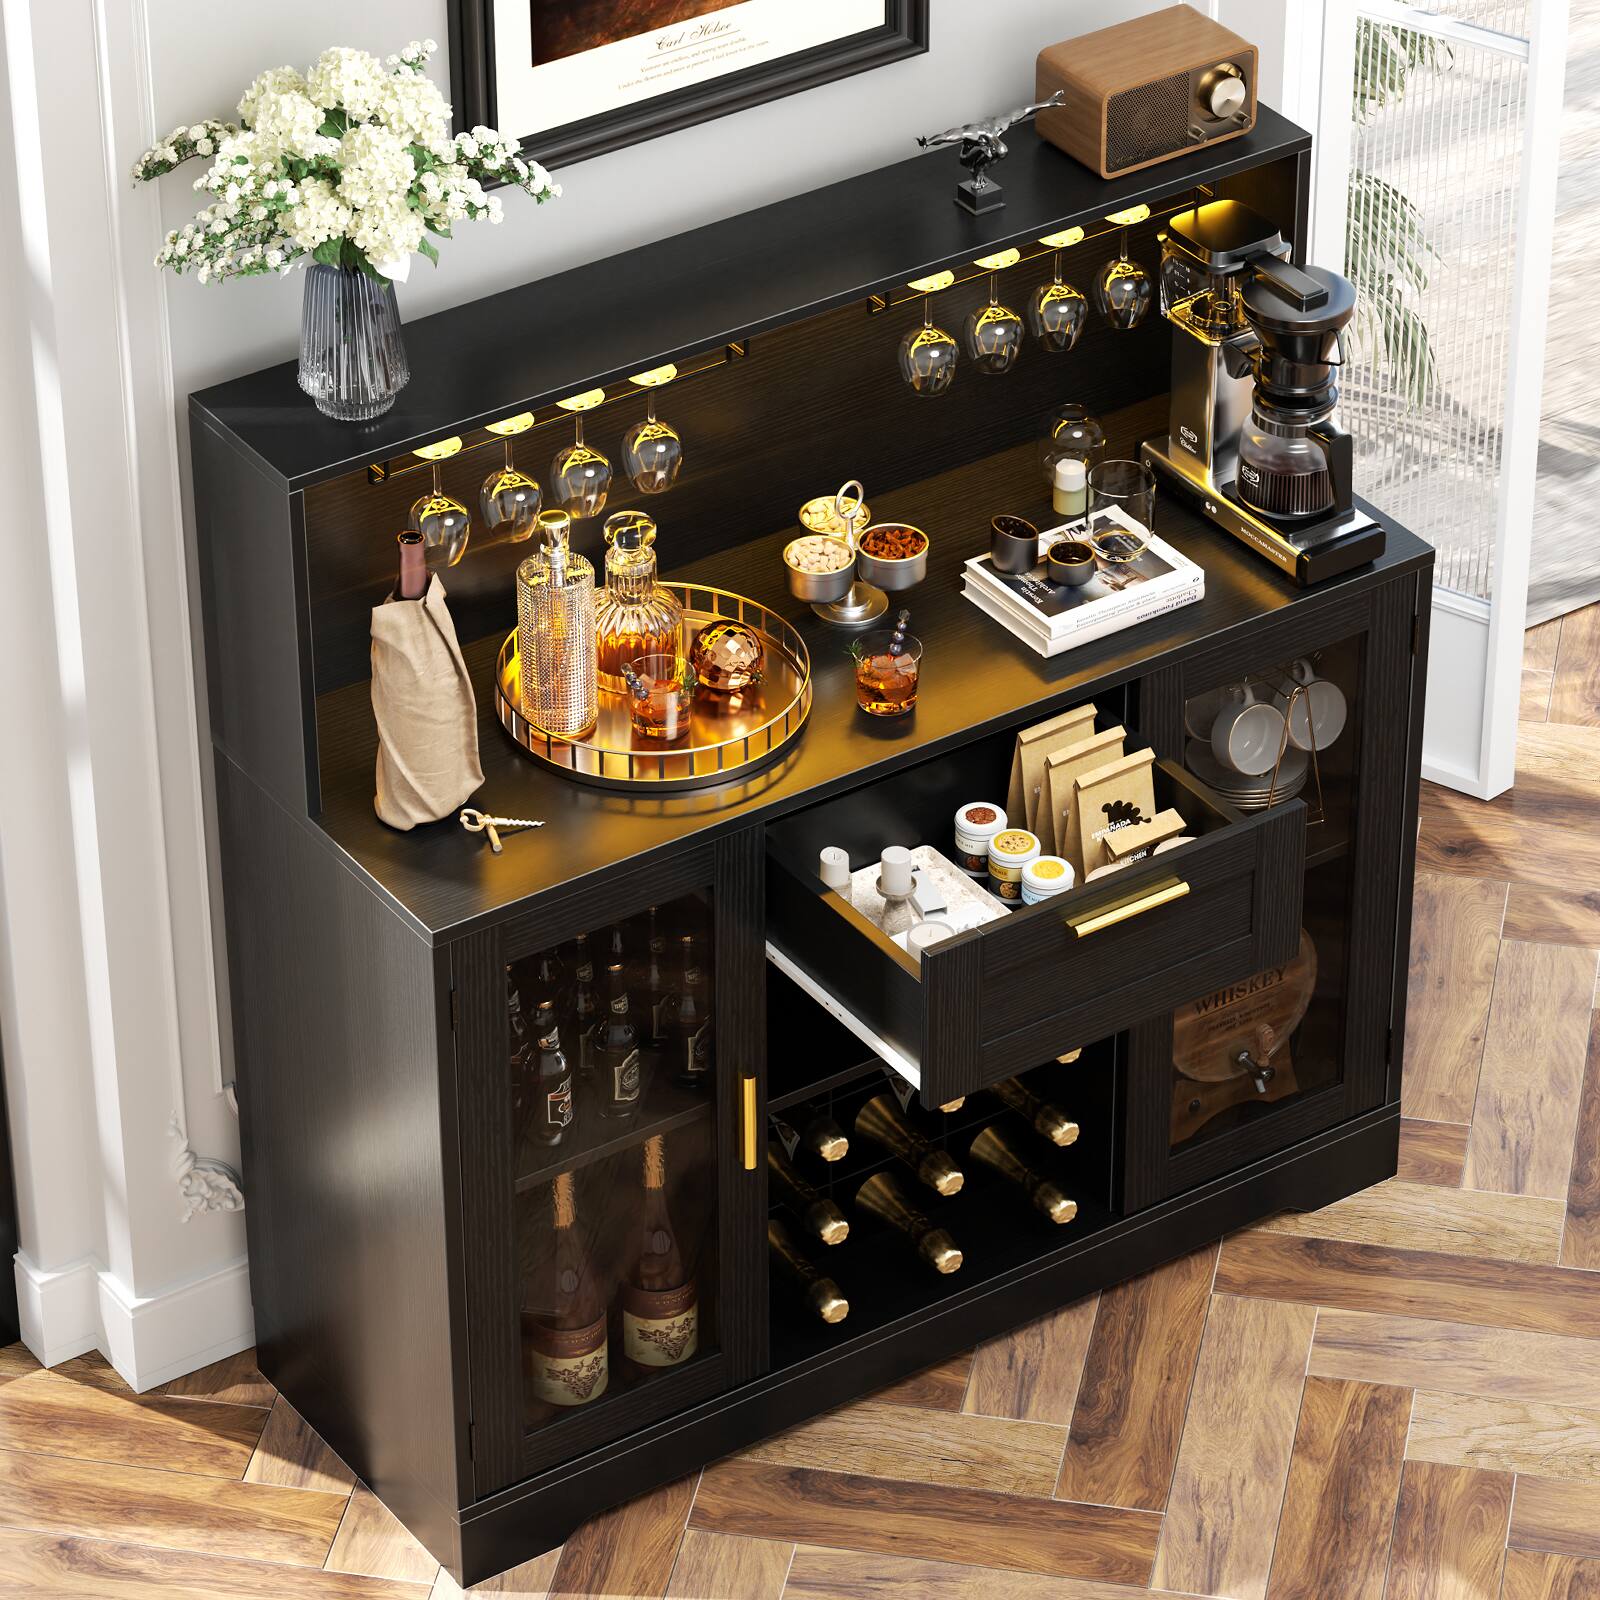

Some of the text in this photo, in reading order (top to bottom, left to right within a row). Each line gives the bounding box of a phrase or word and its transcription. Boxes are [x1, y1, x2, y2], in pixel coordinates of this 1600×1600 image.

[656, 31, 686, 50] Carl
[1240, 526, 1287, 562] MOCCAMASTER
[1195, 965, 1288, 1014] WHISKEY
